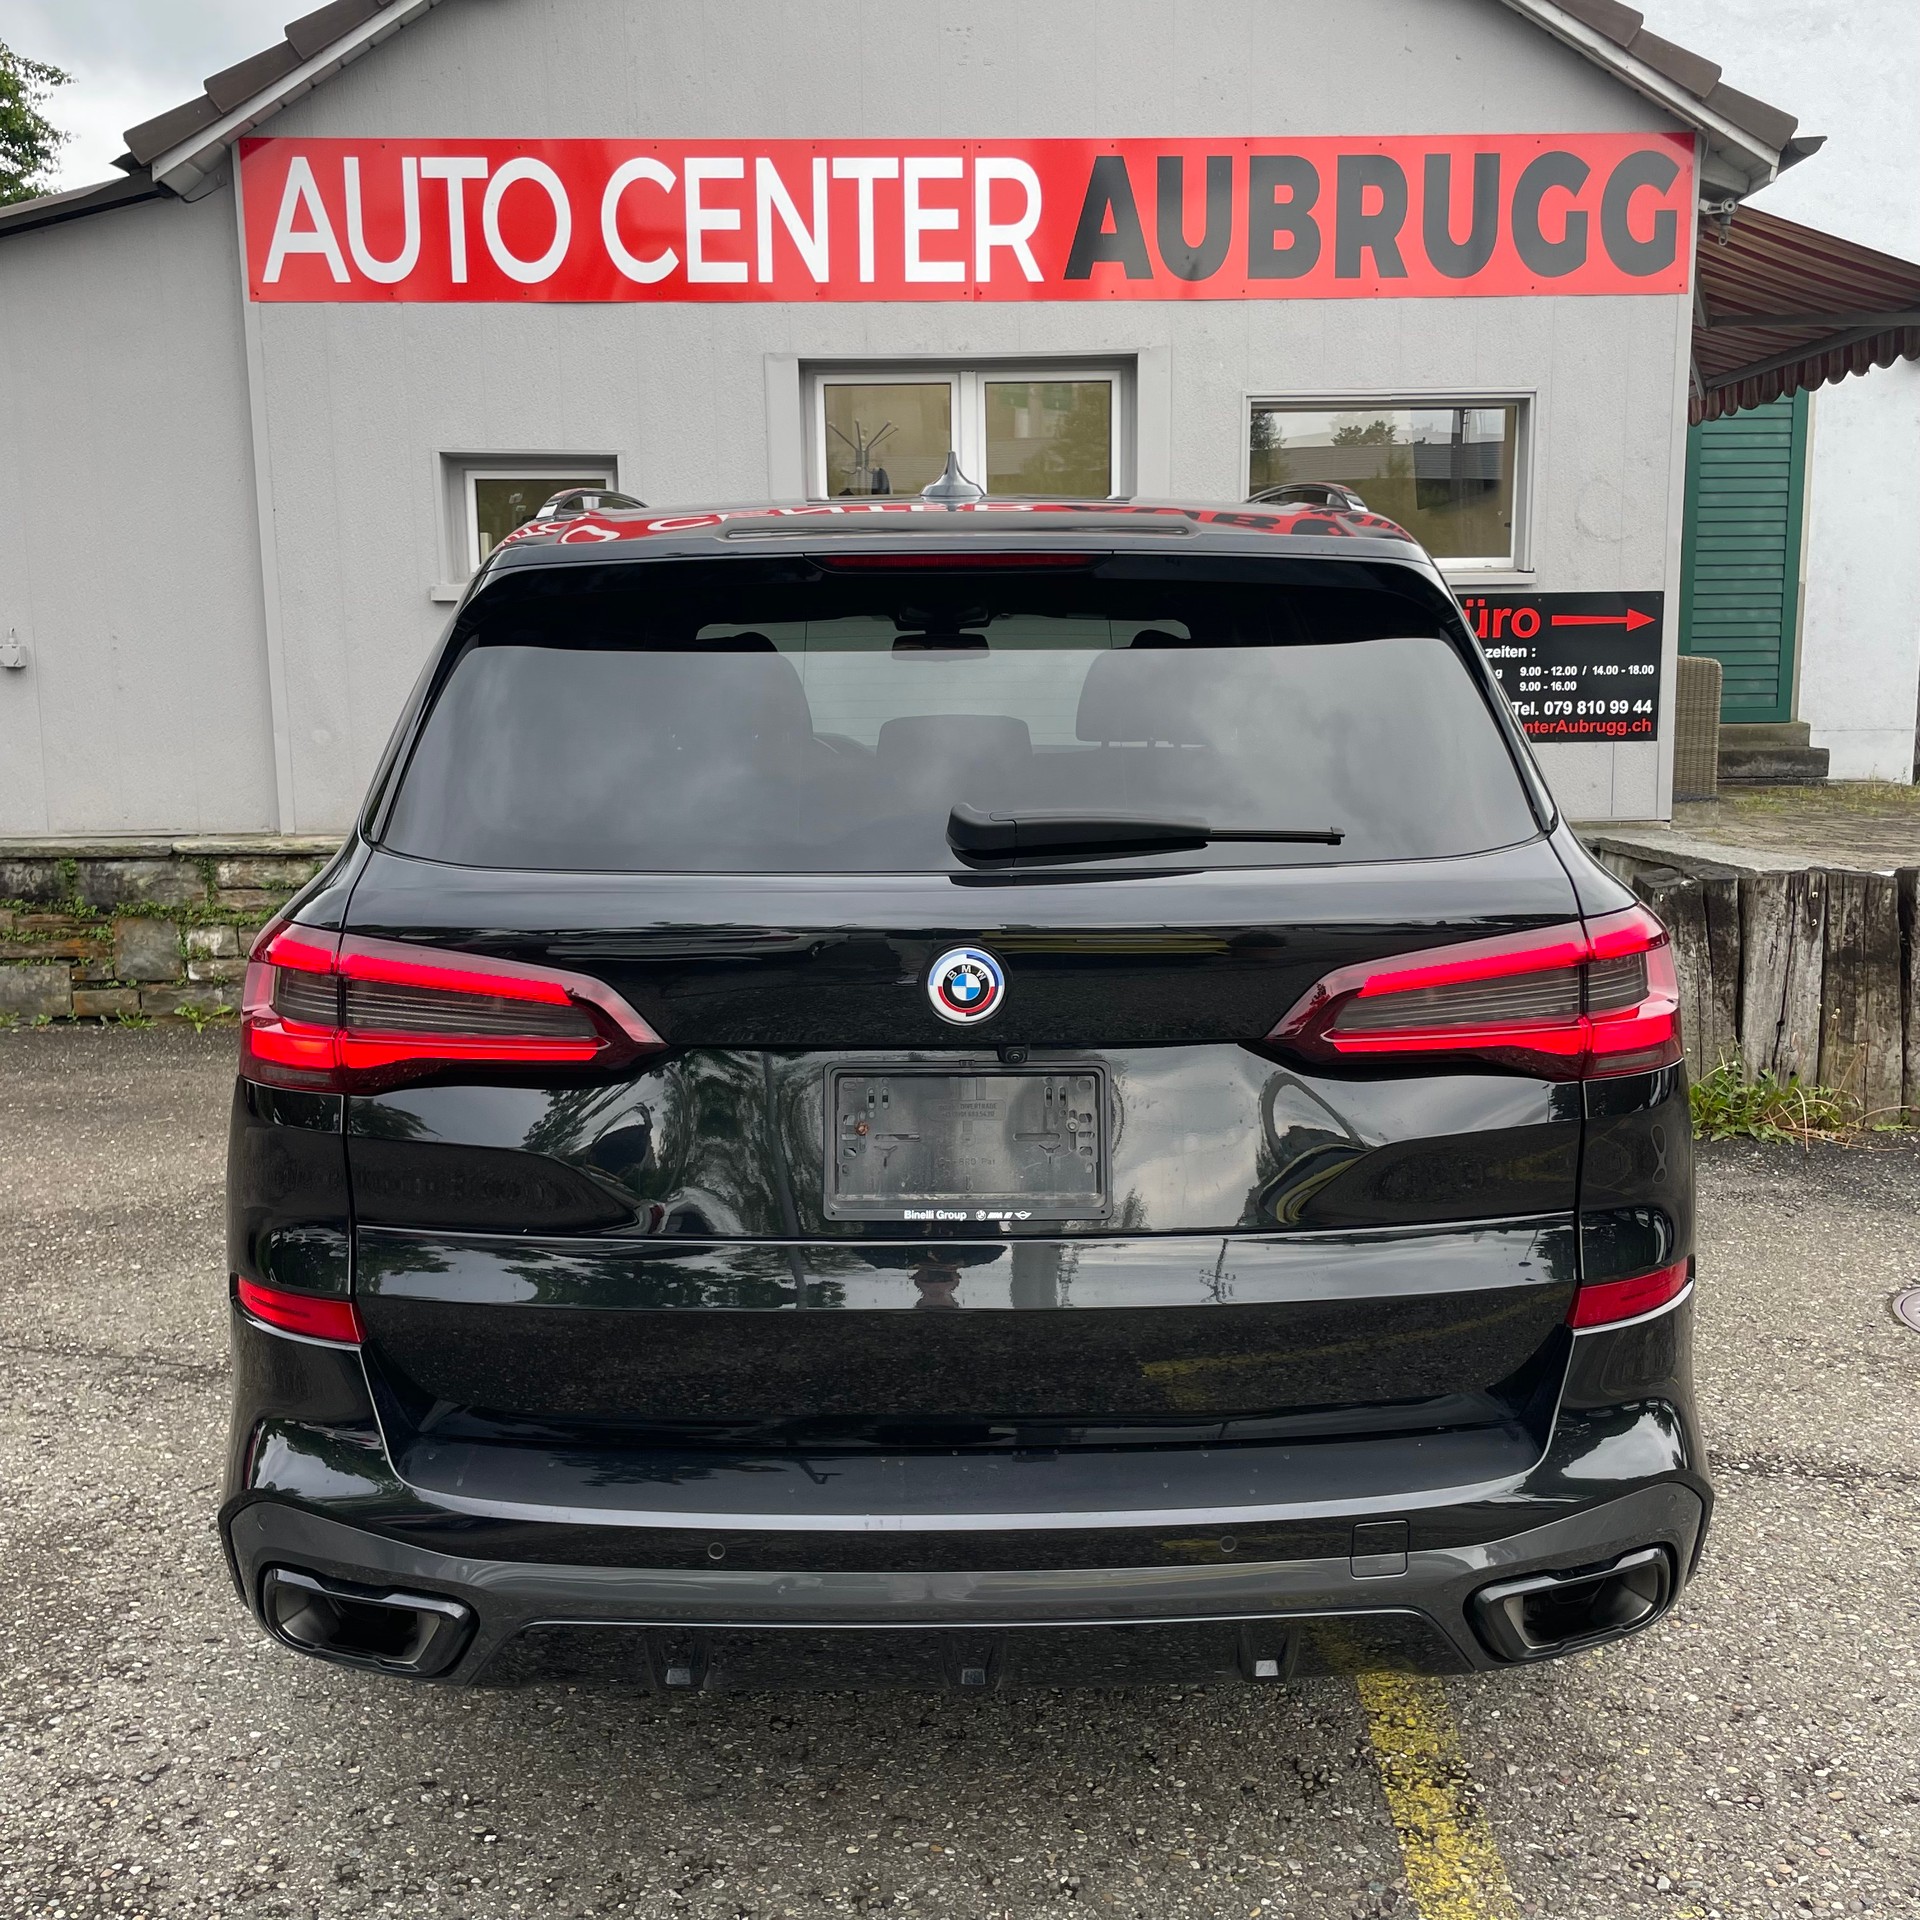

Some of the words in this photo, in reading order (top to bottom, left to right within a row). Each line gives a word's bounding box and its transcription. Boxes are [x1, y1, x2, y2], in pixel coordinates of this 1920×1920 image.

[262, 156, 572, 284] AUTO
[600, 156, 1045, 284] CENTER
[1063, 150, 1681, 282] AUBRUGG
[1463, 598, 1541, 638] üro
[1485, 644, 1528, 659] zeiten
[1519, 666, 1542, 677] 9.00
[1550, 665, 1578, 676] 12.00
[1592, 665, 1619, 676] 14.00
[1627, 664, 1655, 675] 18.00
[1519, 681, 1541, 692] 9.00
[1550, 681, 1577, 692] 16.00
[1510, 701, 1539, 716] Tel.
[1543, 700, 1573, 716] 079
[1576, 700, 1606, 715] 810
[1609, 699, 1629, 715] 99
[1632, 699, 1653, 714] 44
[1523, 717, 1652, 736] nterAubrugg.ch
[946, 963, 987, 981] BMW
[903, 1209, 935, 1220] Binelli
[935, 1209, 968, 1222] Group
